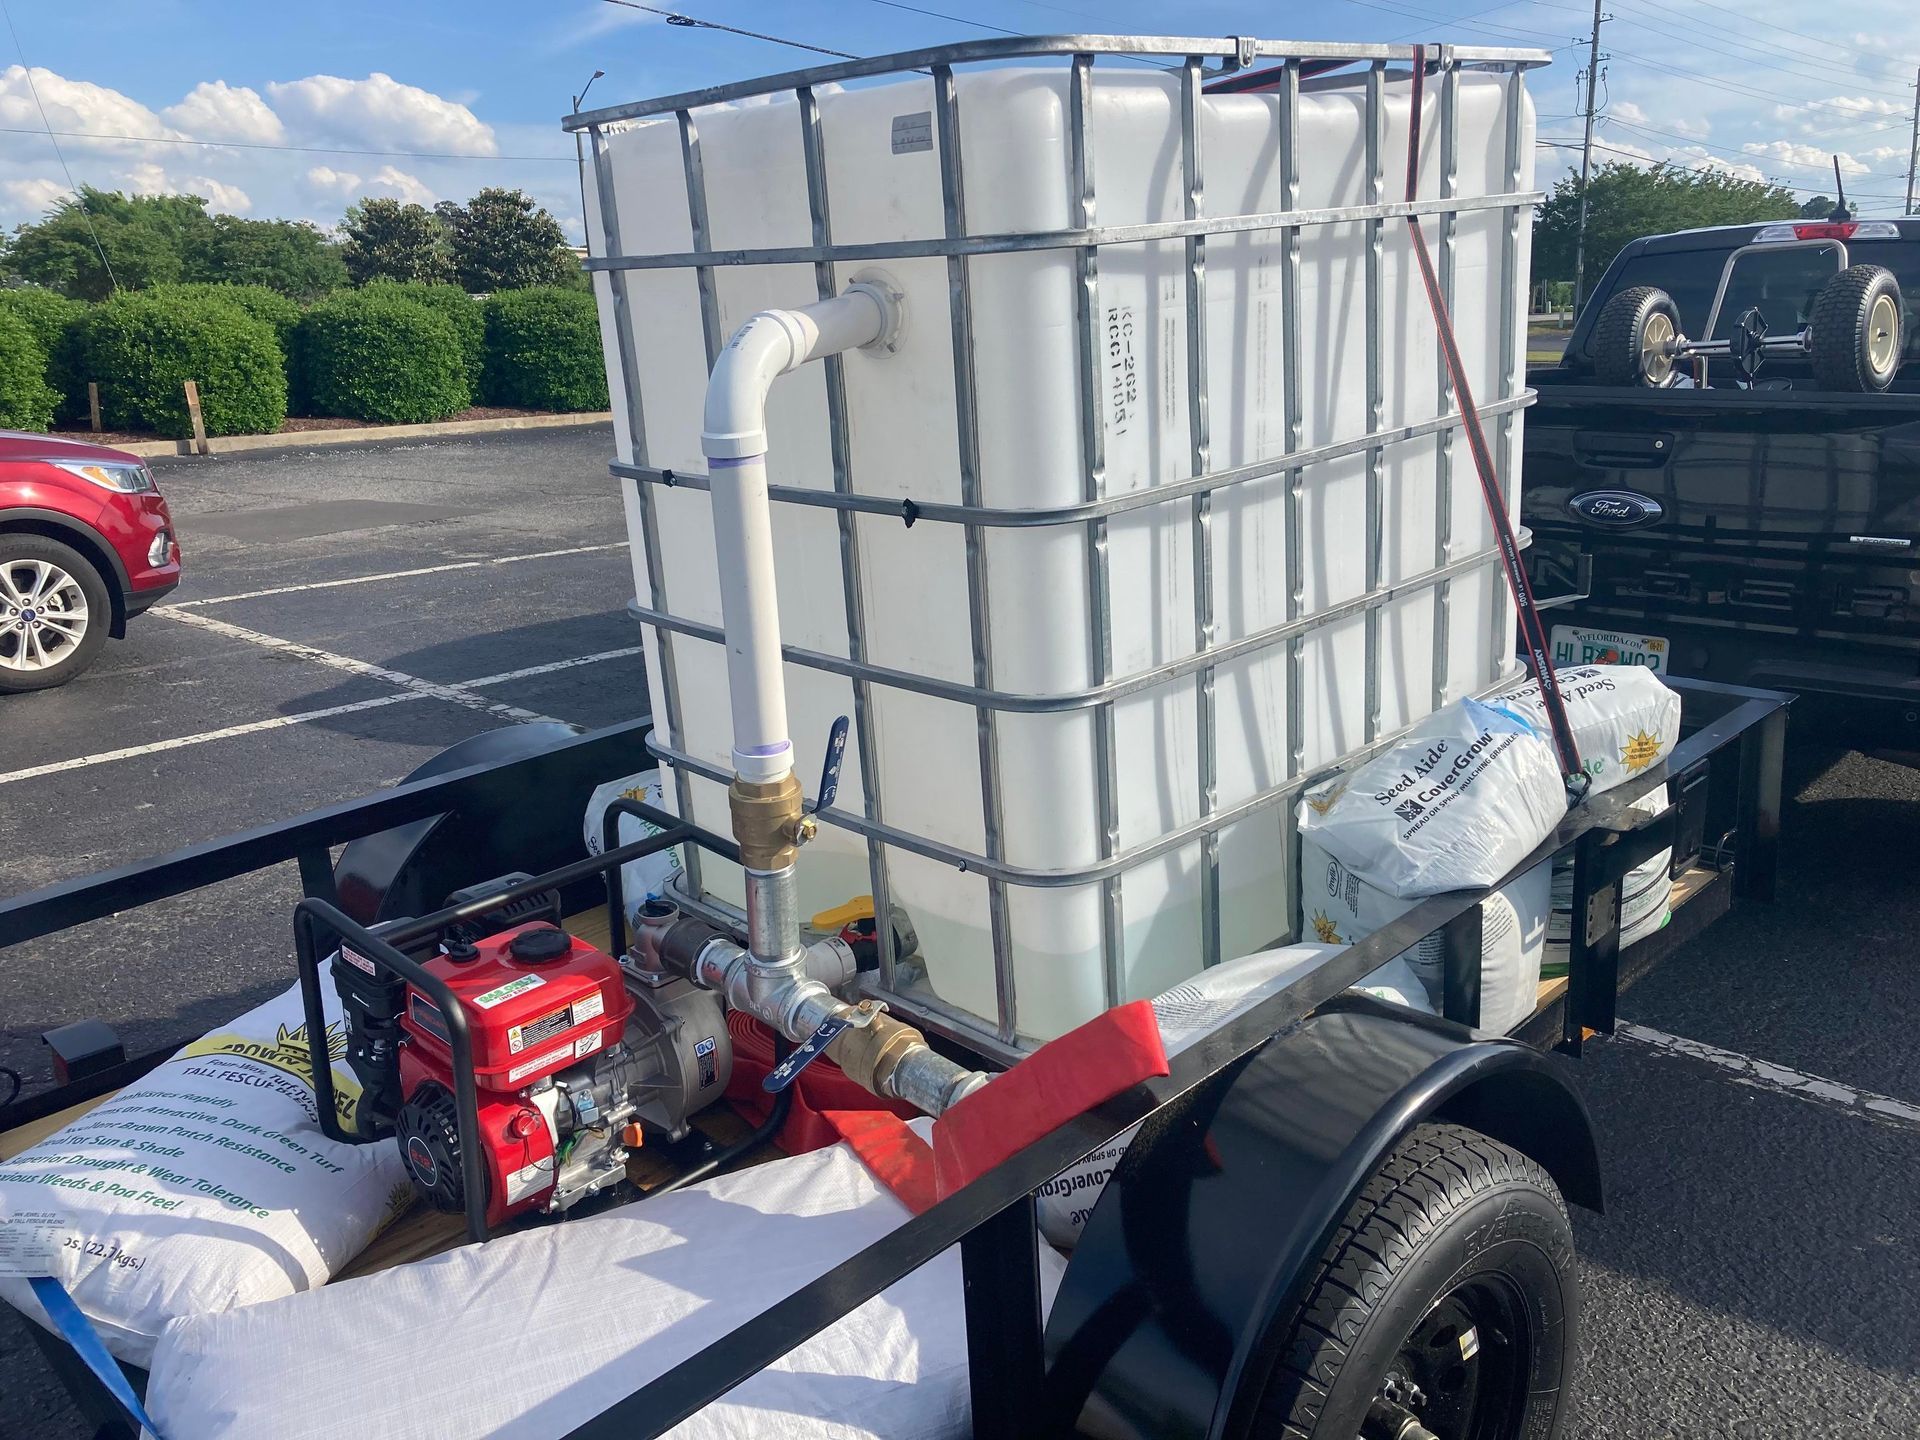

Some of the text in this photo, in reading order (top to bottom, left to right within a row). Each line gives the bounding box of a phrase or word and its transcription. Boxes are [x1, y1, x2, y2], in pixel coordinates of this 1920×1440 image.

[1589, 499, 1631, 519] Ford
[1518, 592, 1528, 607] 500
[1576, 633, 1643, 649] MYFLORIDA.COM
[1534, 649, 1551, 680] HUSKY
[1575, 678, 1616, 699] Seed
[1374, 742, 1448, 806] Seed Aide
[1418, 732, 1493, 802] CoverGrow
[1403, 731, 1519, 841] SPREAD OR SPRAY MULCHING GRANULES
[183, 1067, 215, 1079] TALL
[219, 1071, 276, 1089] FESCUE
[179, 1091, 238, 1109] Rapidly
[69, 1135, 90, 1145] for
[89, 1135, 120, 1146] Sun
[120, 1139, 135, 1148] &
[133, 1141, 185, 1158] Shade
[117, 1122, 171, 1134] Brown
[168, 1126, 214, 1143] Patch
[213, 1137, 297, 1174] Resistance
[142, 1106, 218, 1124] Attractive,
[221, 1118, 262, 1135] Dark
[262, 1130, 307, 1155] Green
[309, 1152, 344, 1174] Turf
[1106, 1149, 1117, 1159] OR
[38, 1173, 90, 1191] Weeds
[89, 1180, 105, 1192] &
[102, 1183, 138, 1199] Poa
[135, 1189, 185, 1211] Free!
[66, 1155, 132, 1171] Drought
[131, 1163, 148, 1173] &
[147, 1166, 193, 1185] Wear
[191, 1178, 270, 1219] Tolerance
